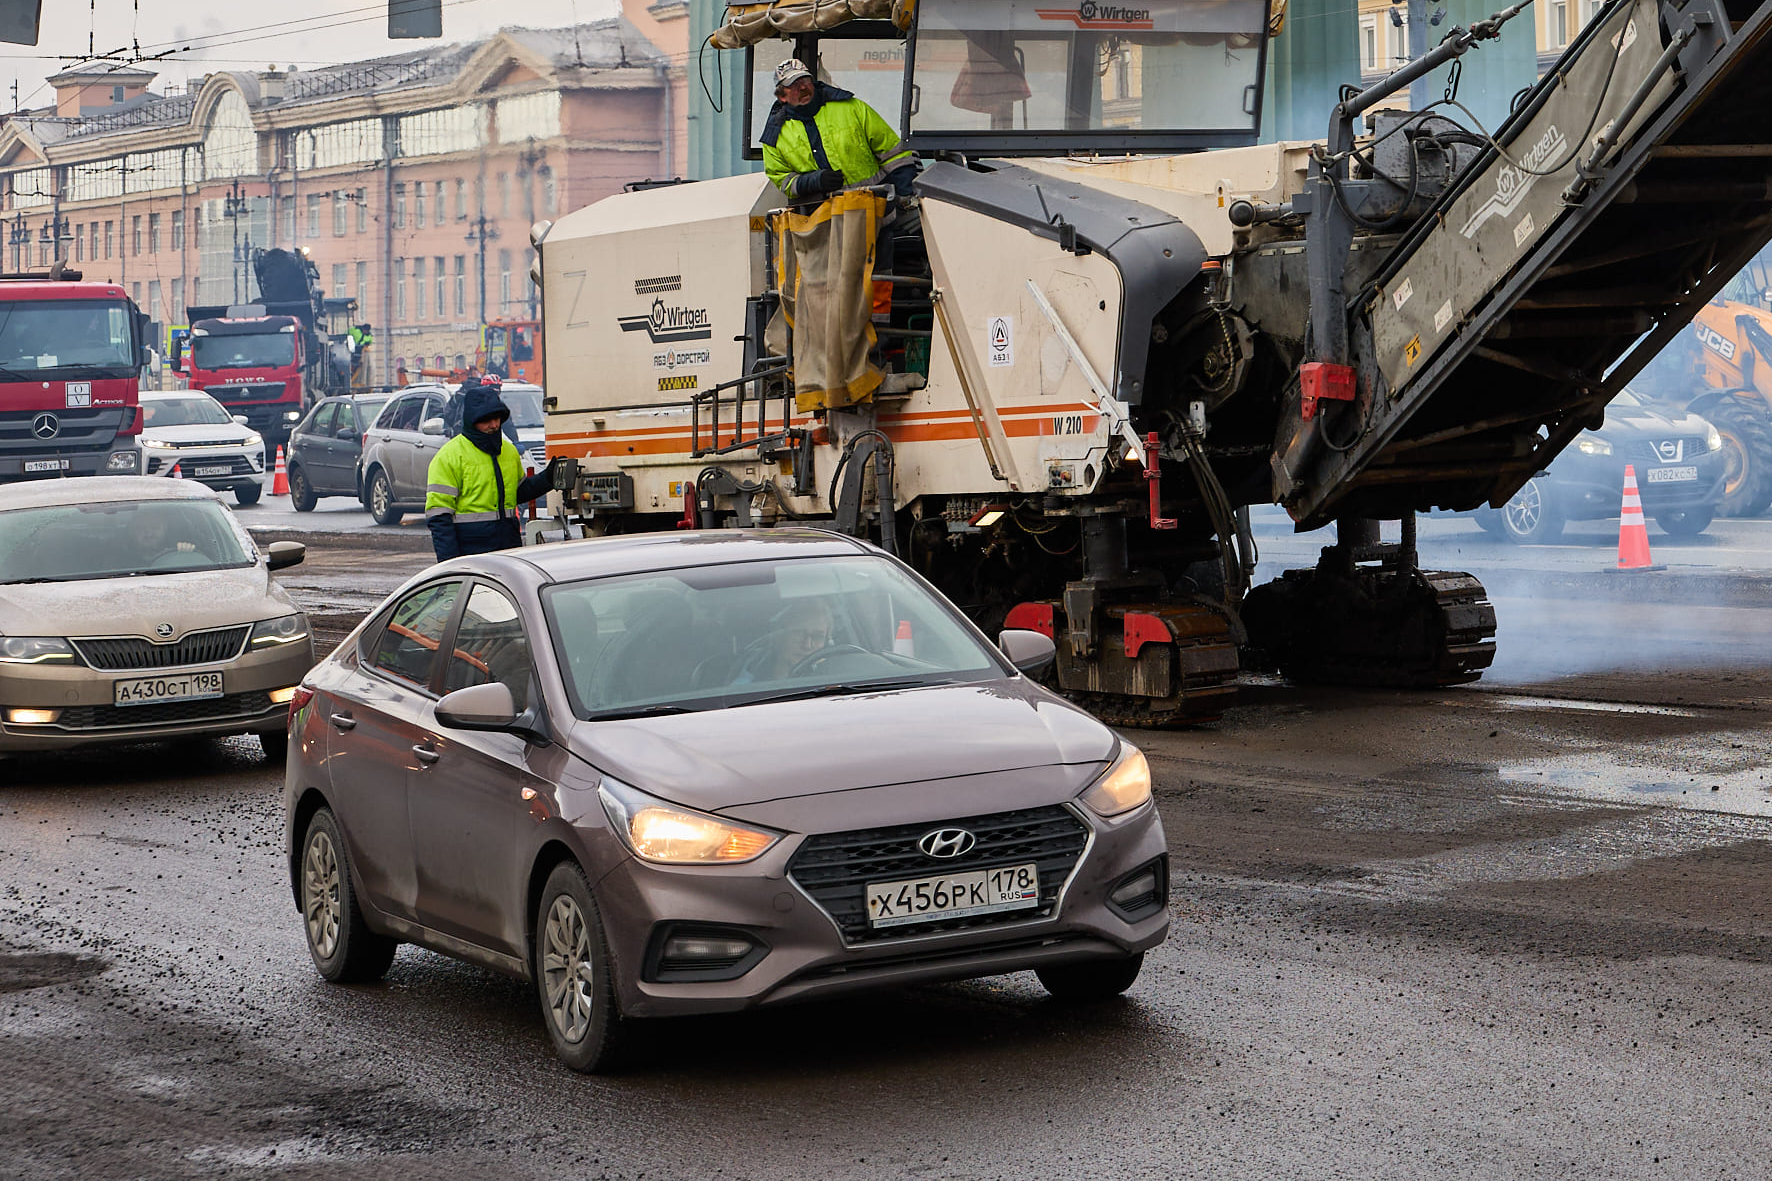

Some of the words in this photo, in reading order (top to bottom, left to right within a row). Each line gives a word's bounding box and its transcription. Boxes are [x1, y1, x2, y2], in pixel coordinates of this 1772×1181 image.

[1100, 6, 1150, 22] Wirtgen
[1515, 124, 1559, 181] Wirtgen
[667, 307, 708, 329] Wirtgen
[1696, 325, 1735, 359] JCB
[677, 349, 710, 365] ДОРСТРОЙ
[1053, 417, 1063, 435] W
[1066, 416, 1082, 435] 210
[121, 680, 189, 700] А430СТ
[193, 674, 218, 689] 198
[877, 880, 985, 917] Х456РК
[991, 868, 1029, 893] 178
[1001, 891, 1021, 901] RUS
